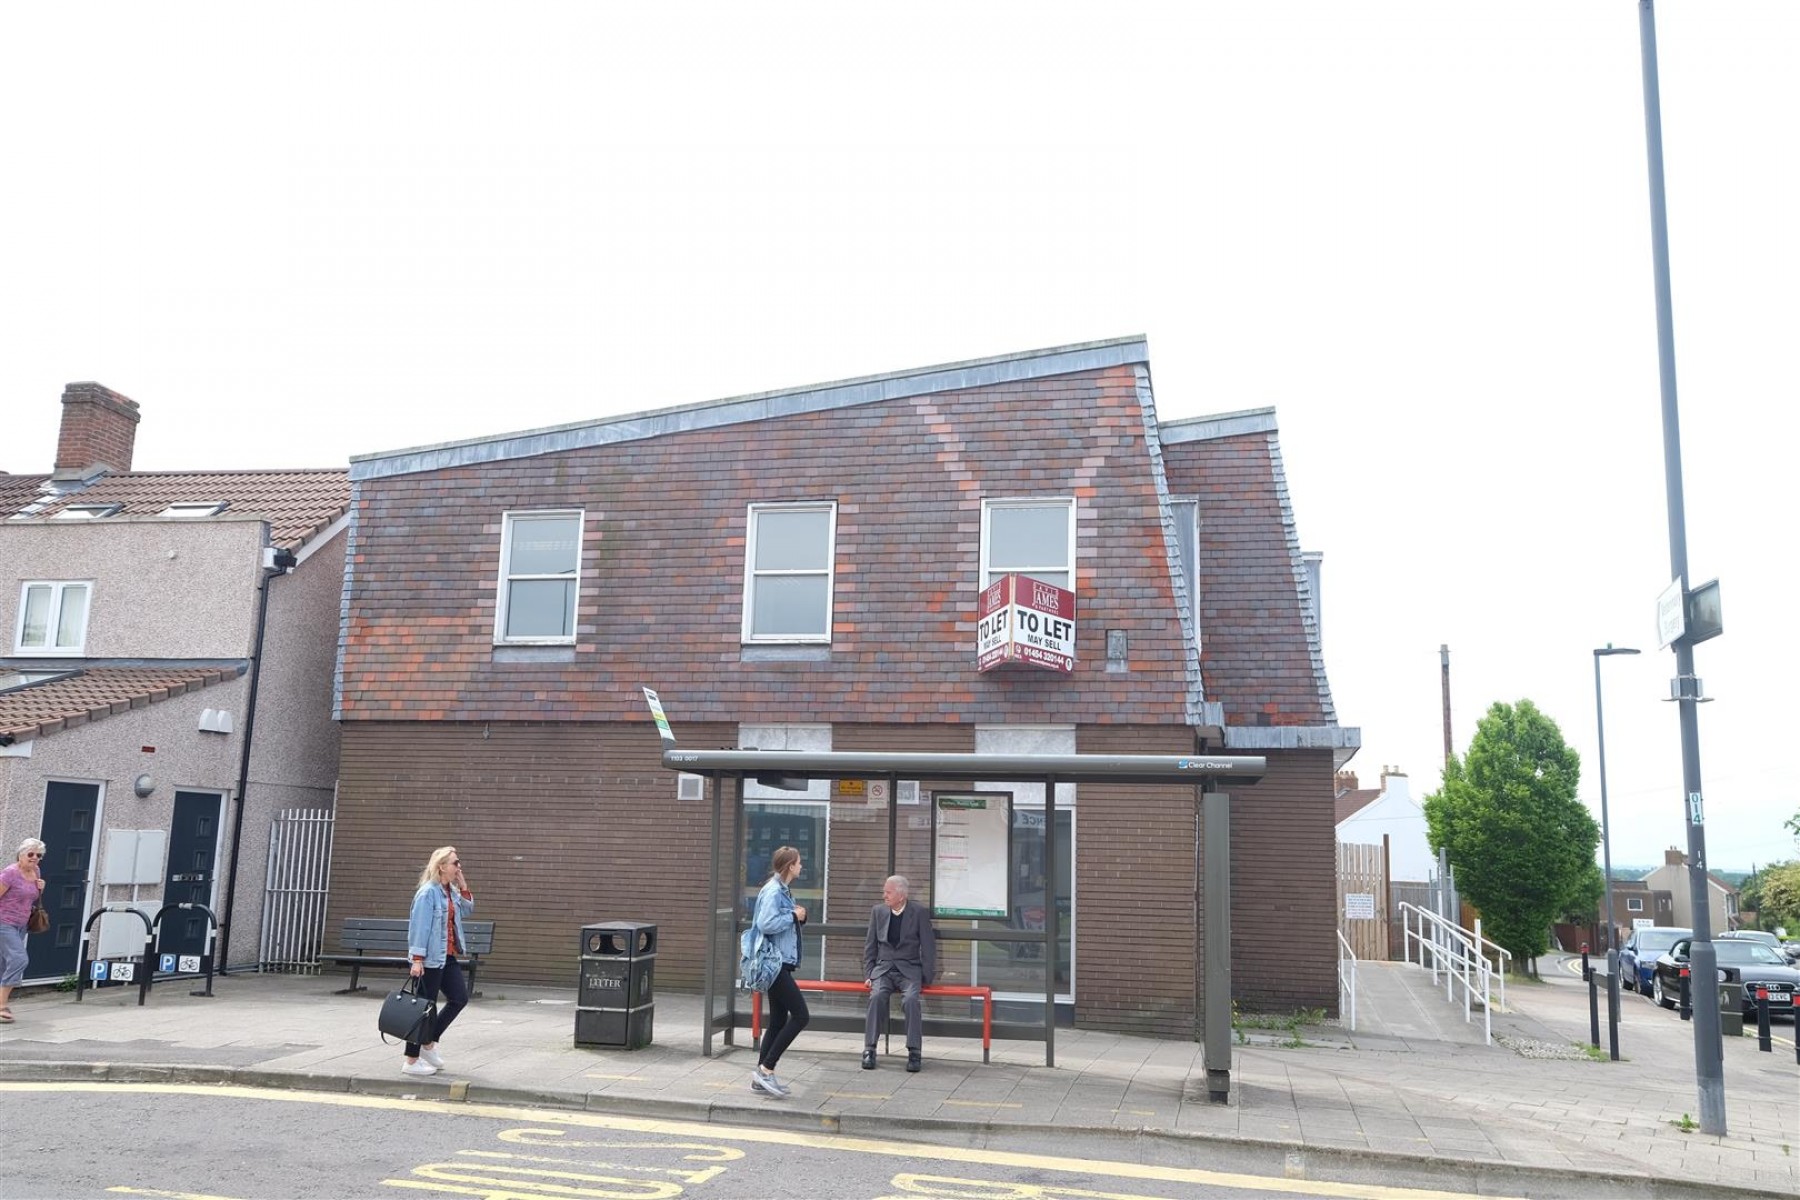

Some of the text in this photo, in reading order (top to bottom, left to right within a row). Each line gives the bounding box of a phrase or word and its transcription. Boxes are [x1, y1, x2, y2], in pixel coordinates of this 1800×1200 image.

[1032, 589, 1059, 610] JAMES
[980, 609, 1008, 641] TO LET
[1017, 609, 1071, 641] TO LET
[1027, 633, 1061, 651] MAY SELL
[1206, 761, 1233, 769] Channel
[94, 963, 104, 978] P
[163, 955, 173, 970] P
